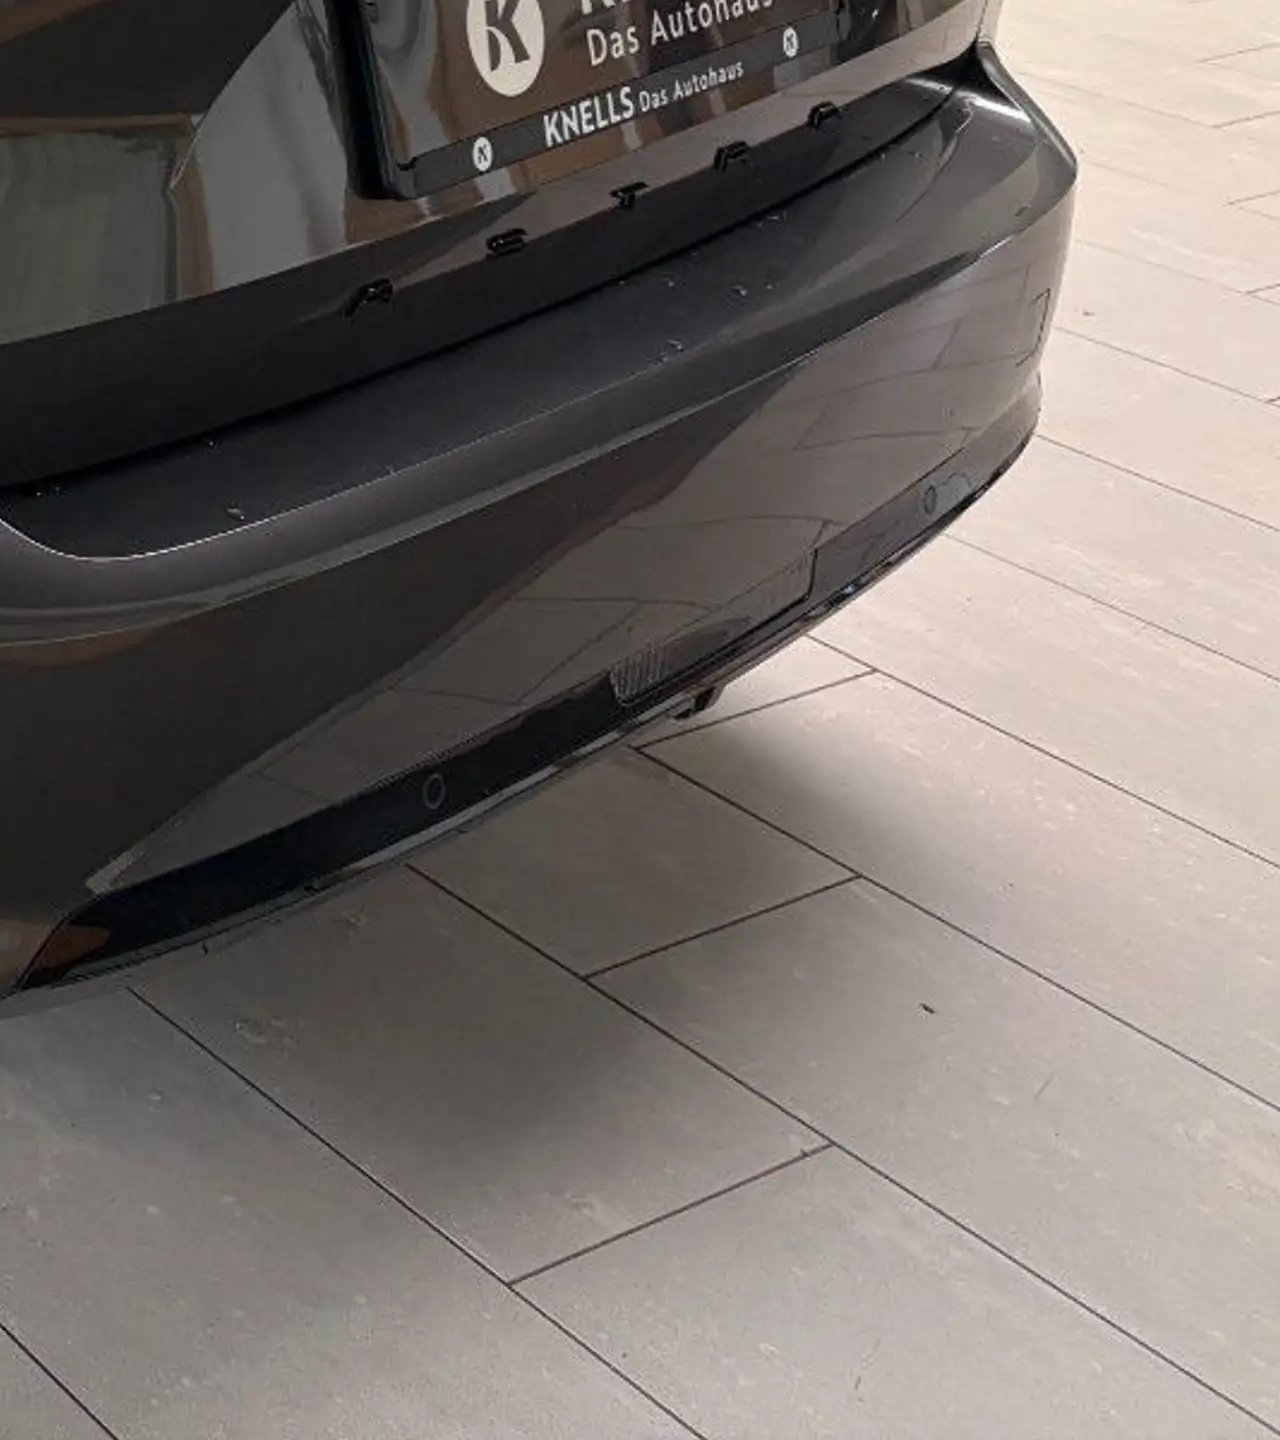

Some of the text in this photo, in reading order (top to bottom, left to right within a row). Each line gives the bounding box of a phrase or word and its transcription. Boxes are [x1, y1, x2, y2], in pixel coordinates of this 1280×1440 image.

[586, 25, 640, 67] Das
[542, 60, 745, 148] KNELLS Das Autohaus
